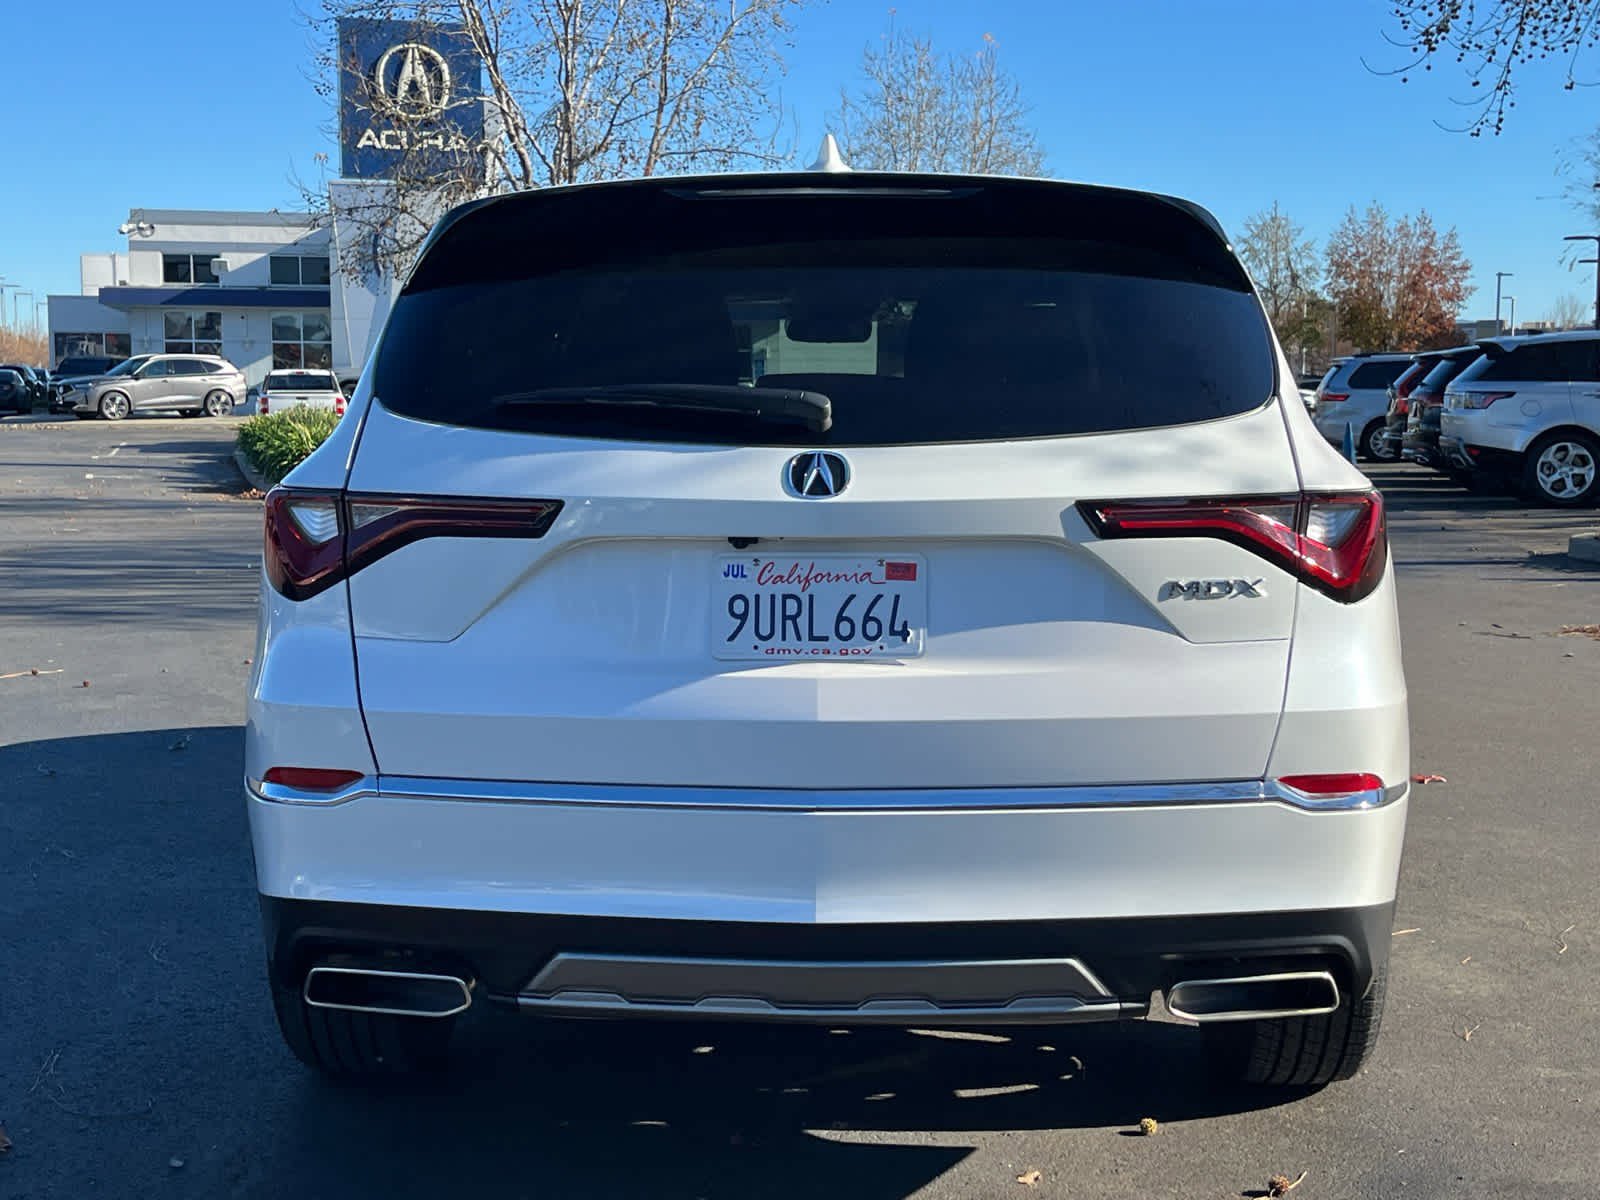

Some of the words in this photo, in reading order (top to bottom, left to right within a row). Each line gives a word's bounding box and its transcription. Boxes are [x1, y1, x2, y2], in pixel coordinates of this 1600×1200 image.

[722, 563, 748, 579] JUL
[757, 561, 887, 593] California
[1157, 578, 1264, 602] MDX
[726, 593, 911, 643] 9URL664
[764, 646, 873, 657] dmv.ca.gov
